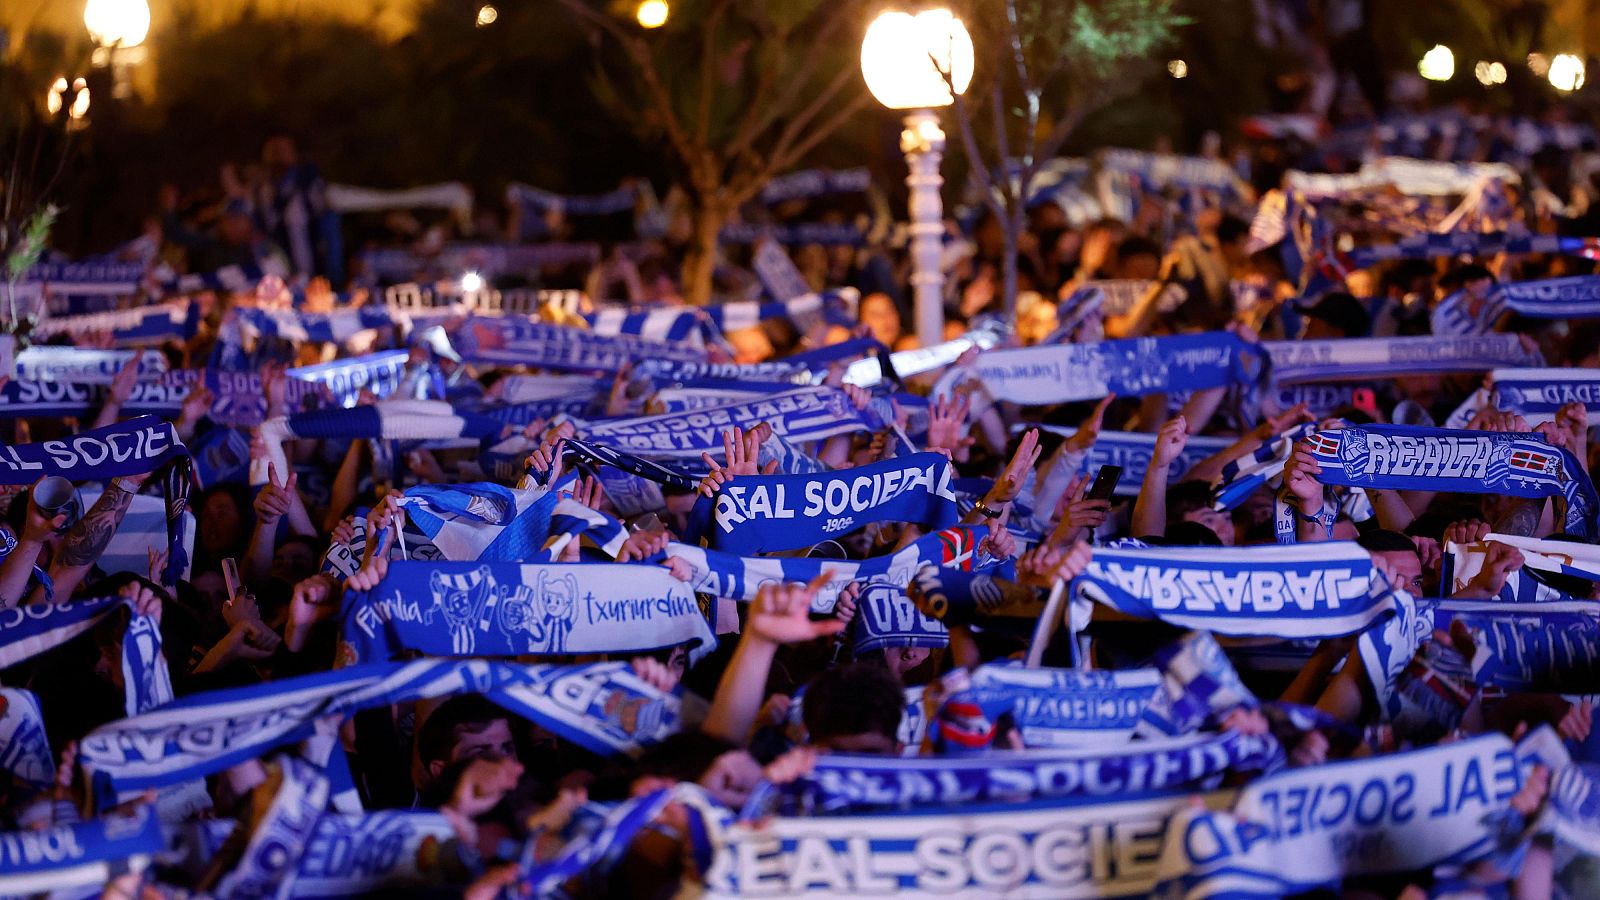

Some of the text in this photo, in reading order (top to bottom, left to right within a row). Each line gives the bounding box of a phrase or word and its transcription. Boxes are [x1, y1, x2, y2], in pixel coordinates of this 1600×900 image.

[1364, 434, 1494, 479] REALA
[715, 484, 795, 534] REAL
[355, 590, 424, 639] Familia
